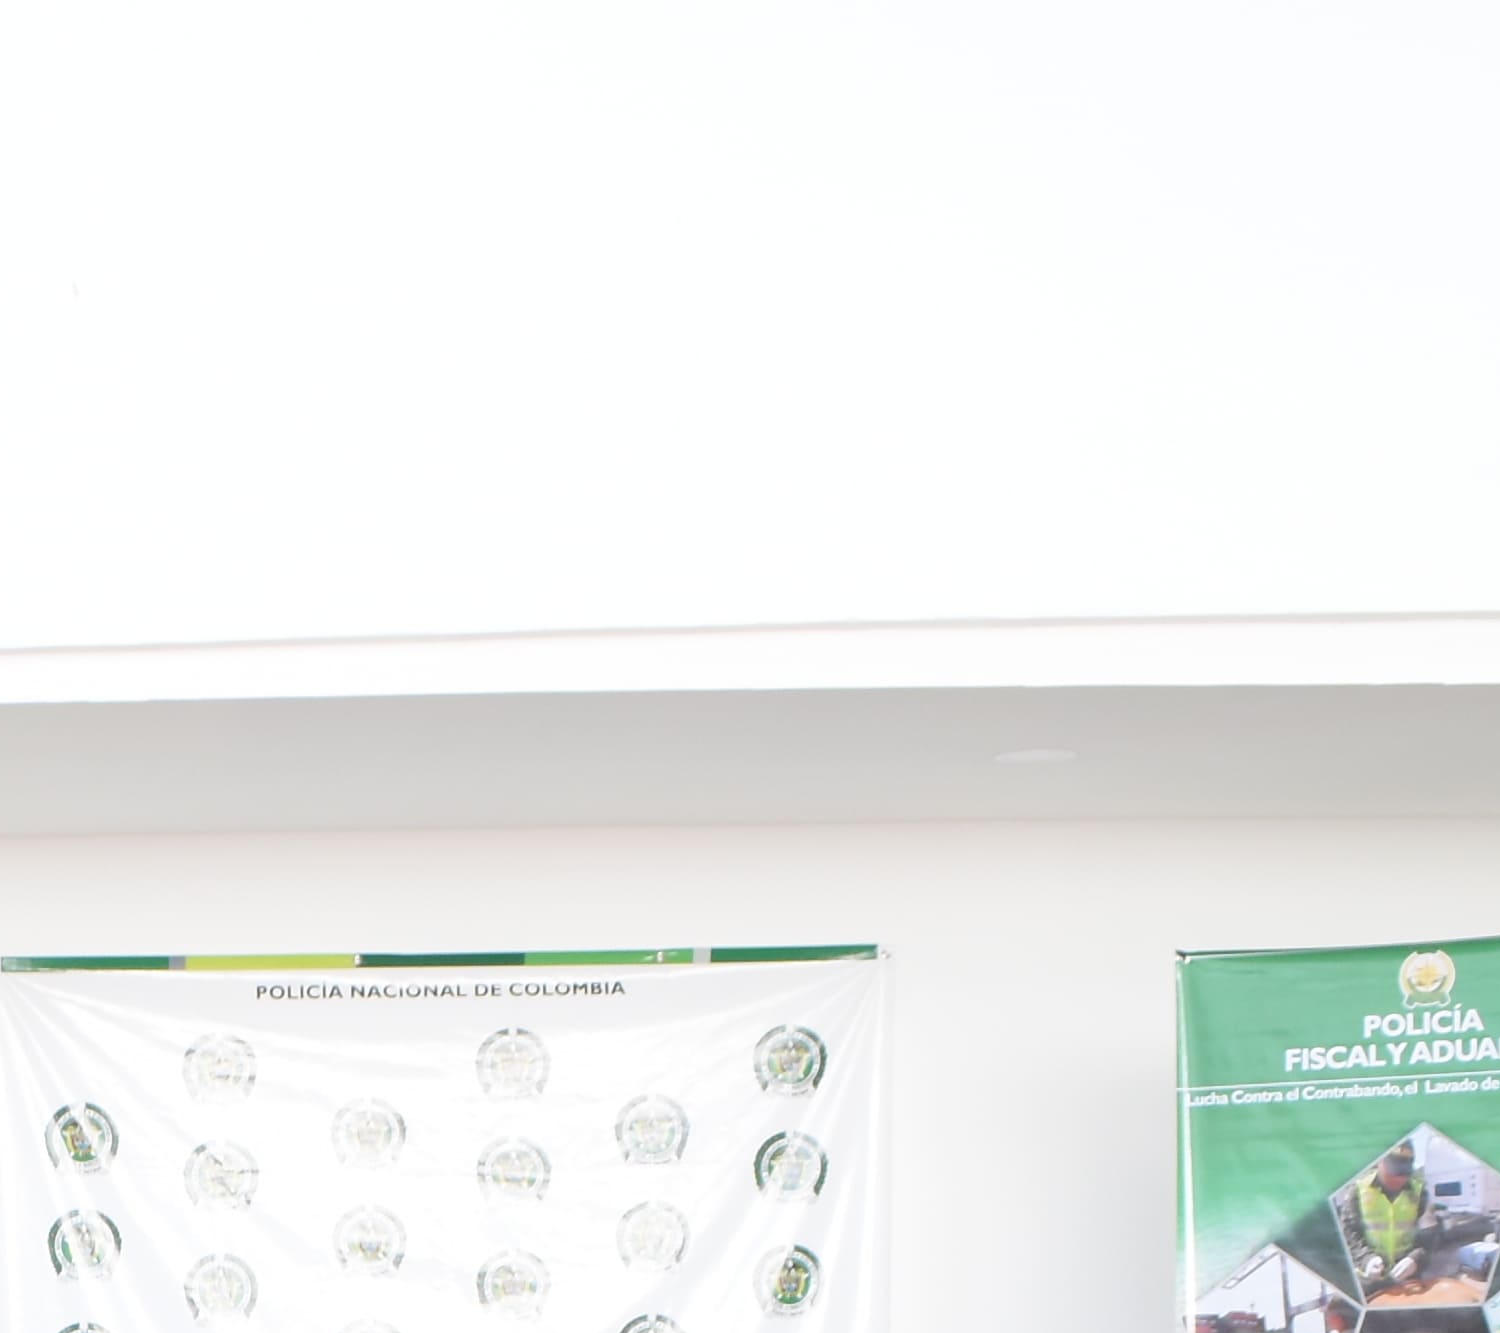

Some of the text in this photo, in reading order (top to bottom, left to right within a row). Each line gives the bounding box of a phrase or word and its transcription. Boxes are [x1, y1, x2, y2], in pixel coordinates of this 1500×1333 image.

[256, 980, 626, 1000] POLICÍA NACIONAL DE COLOMBIA
[1363, 1004, 1484, 1039] POLICÍA
[1284, 1044, 1386, 1073] FISCAL
[1386, 1042, 1408, 1066] Y
[1187, 1090, 1229, 1108] Lucha
[1231, 1088, 1283, 1105] Contra
[1286, 1087, 1299, 1102] el
[1424, 1073, 1479, 1094] Lavado
[1481, 1073, 1499, 1090] de
